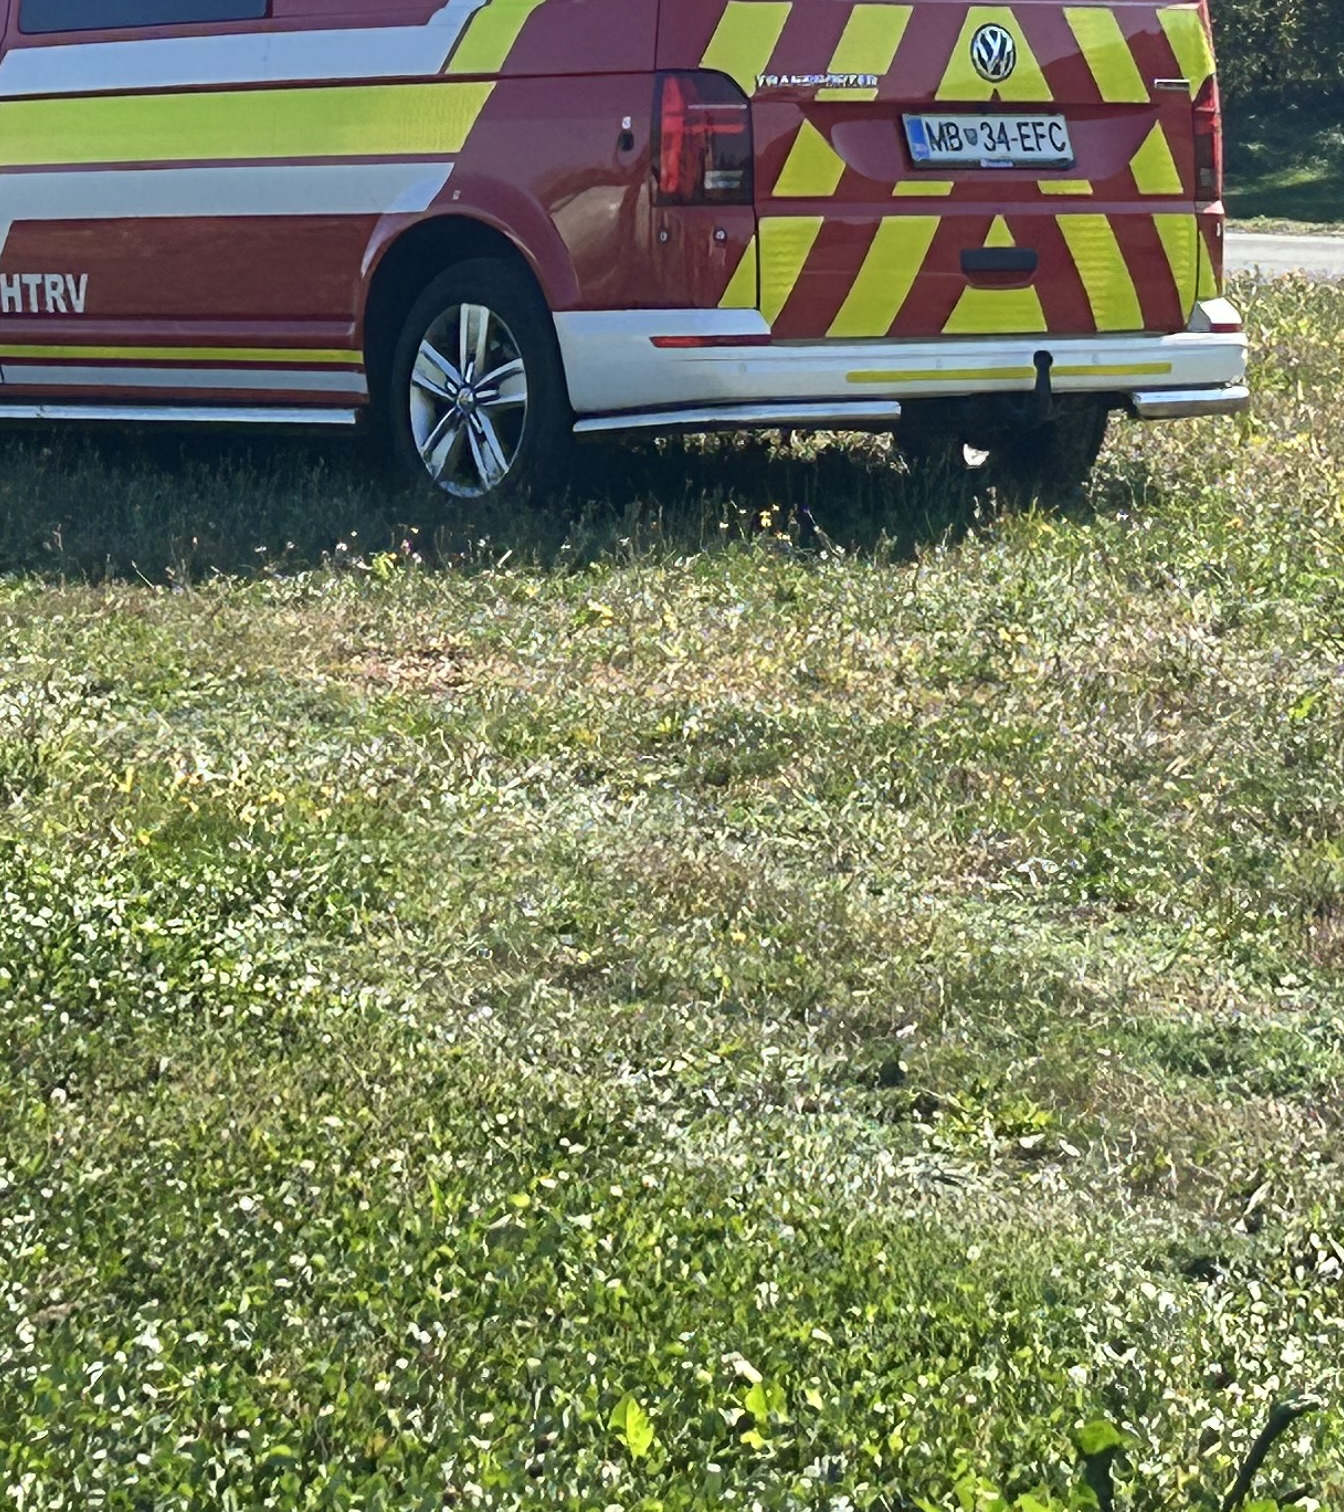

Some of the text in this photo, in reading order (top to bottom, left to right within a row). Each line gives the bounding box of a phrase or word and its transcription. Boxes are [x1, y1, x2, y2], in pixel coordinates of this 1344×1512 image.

[924, 121, 1067, 153] MB 34-EFC
[0, 273, 89, 313] HTRV
